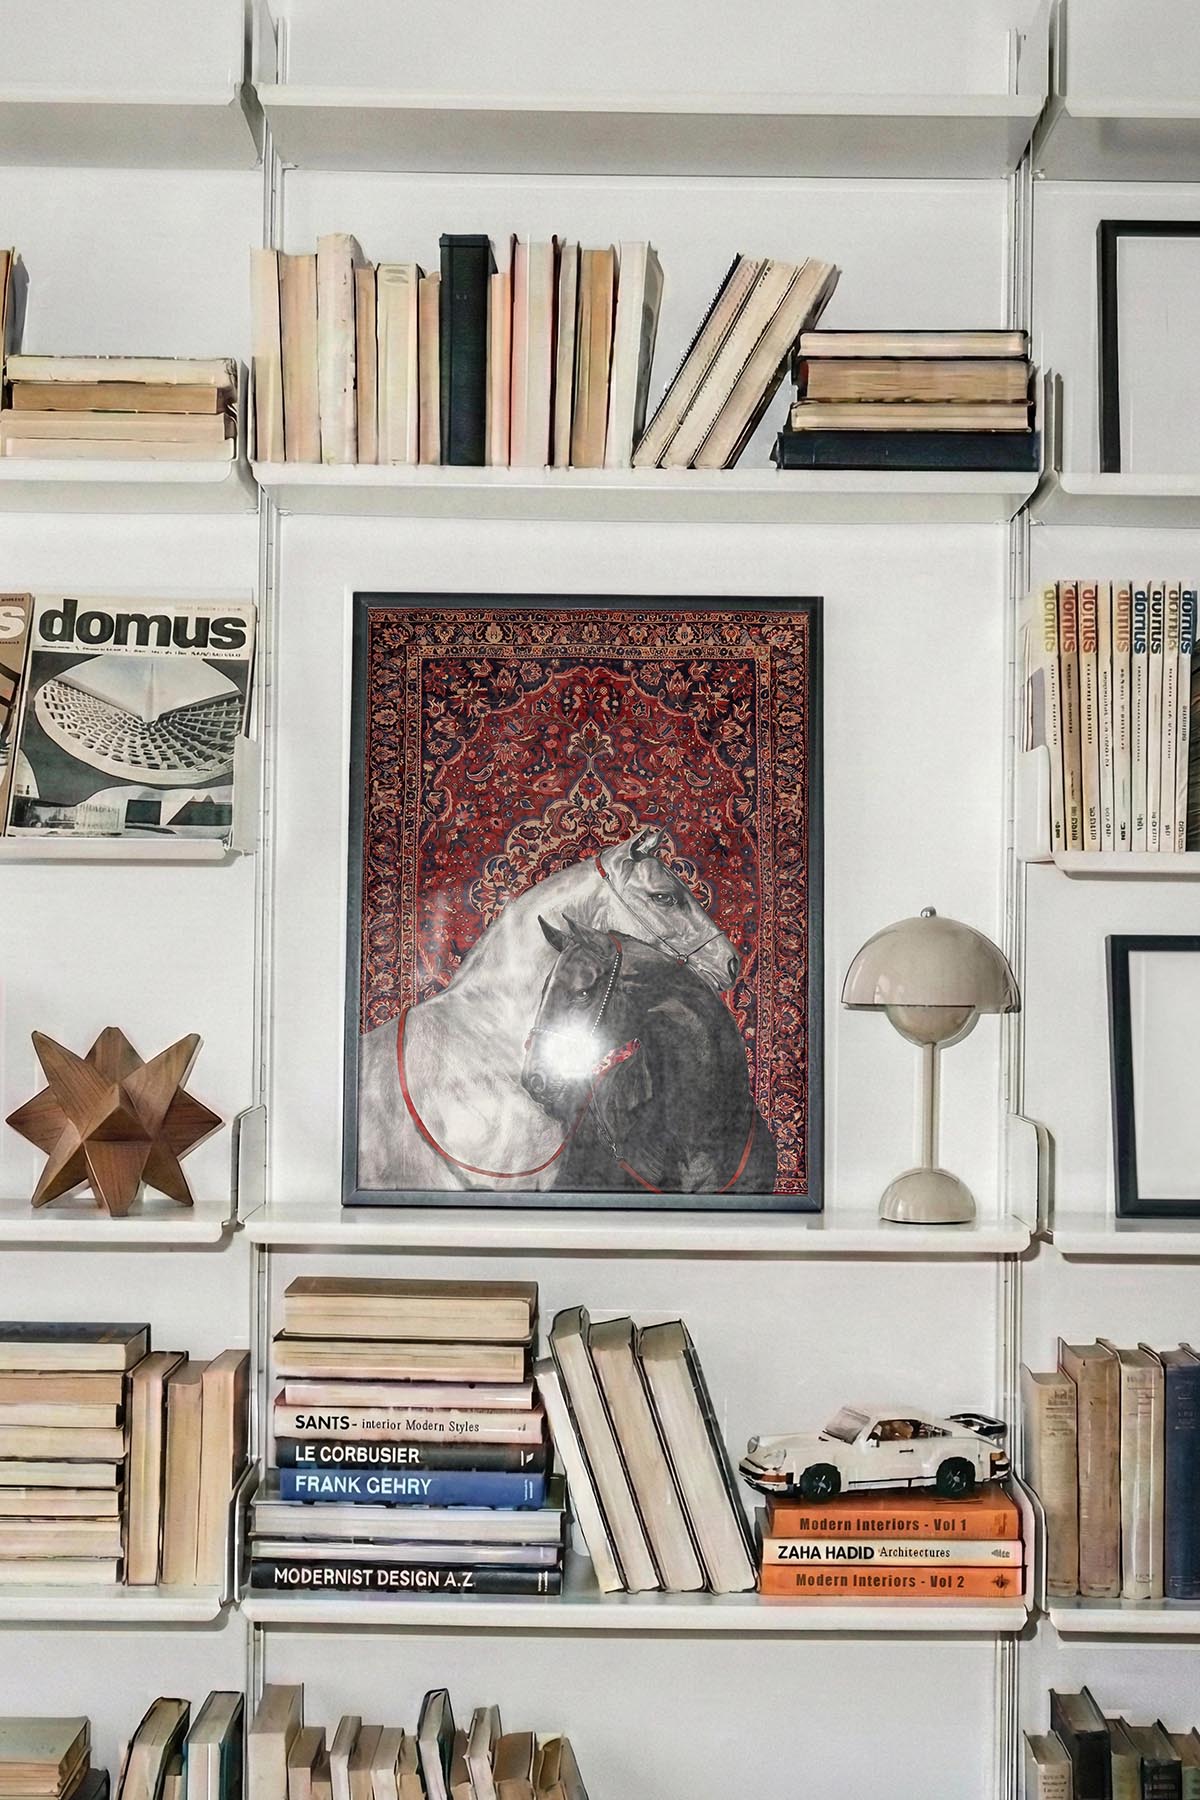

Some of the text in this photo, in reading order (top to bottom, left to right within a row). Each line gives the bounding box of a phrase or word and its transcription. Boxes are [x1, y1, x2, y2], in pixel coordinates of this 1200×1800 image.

[39, 599, 247, 649] domus
[1134, 590, 1147, 654] domus
[1181, 590, 1193, 655] domus
[362, 1418, 401, 1431] interior
[405, 1418, 444, 1432] Modern
[448, 1420, 479, 1434] Styles
[295, 1446, 420, 1463] LE CORBUSIER
[295, 1475, 432, 1496] FRANK GEHRY
[800, 1517, 851, 1531] Modern
[856, 1517, 919, 1531] Interiors
[934, 1518, 956, 1531] Vol
[960, 1518, 967, 1531] 1
[778, 1546, 951, 1560] ZAHA HADID Architectures
[274, 1567, 373, 1586] MODERNIST
[377, 1570, 439, 1587] DESIGN
[796, 1573, 848, 1587] Modern
[853, 1573, 916, 1588] Interiors
[930, 1575, 952, 1588] Vol
[957, 1575, 965, 1588] 2
